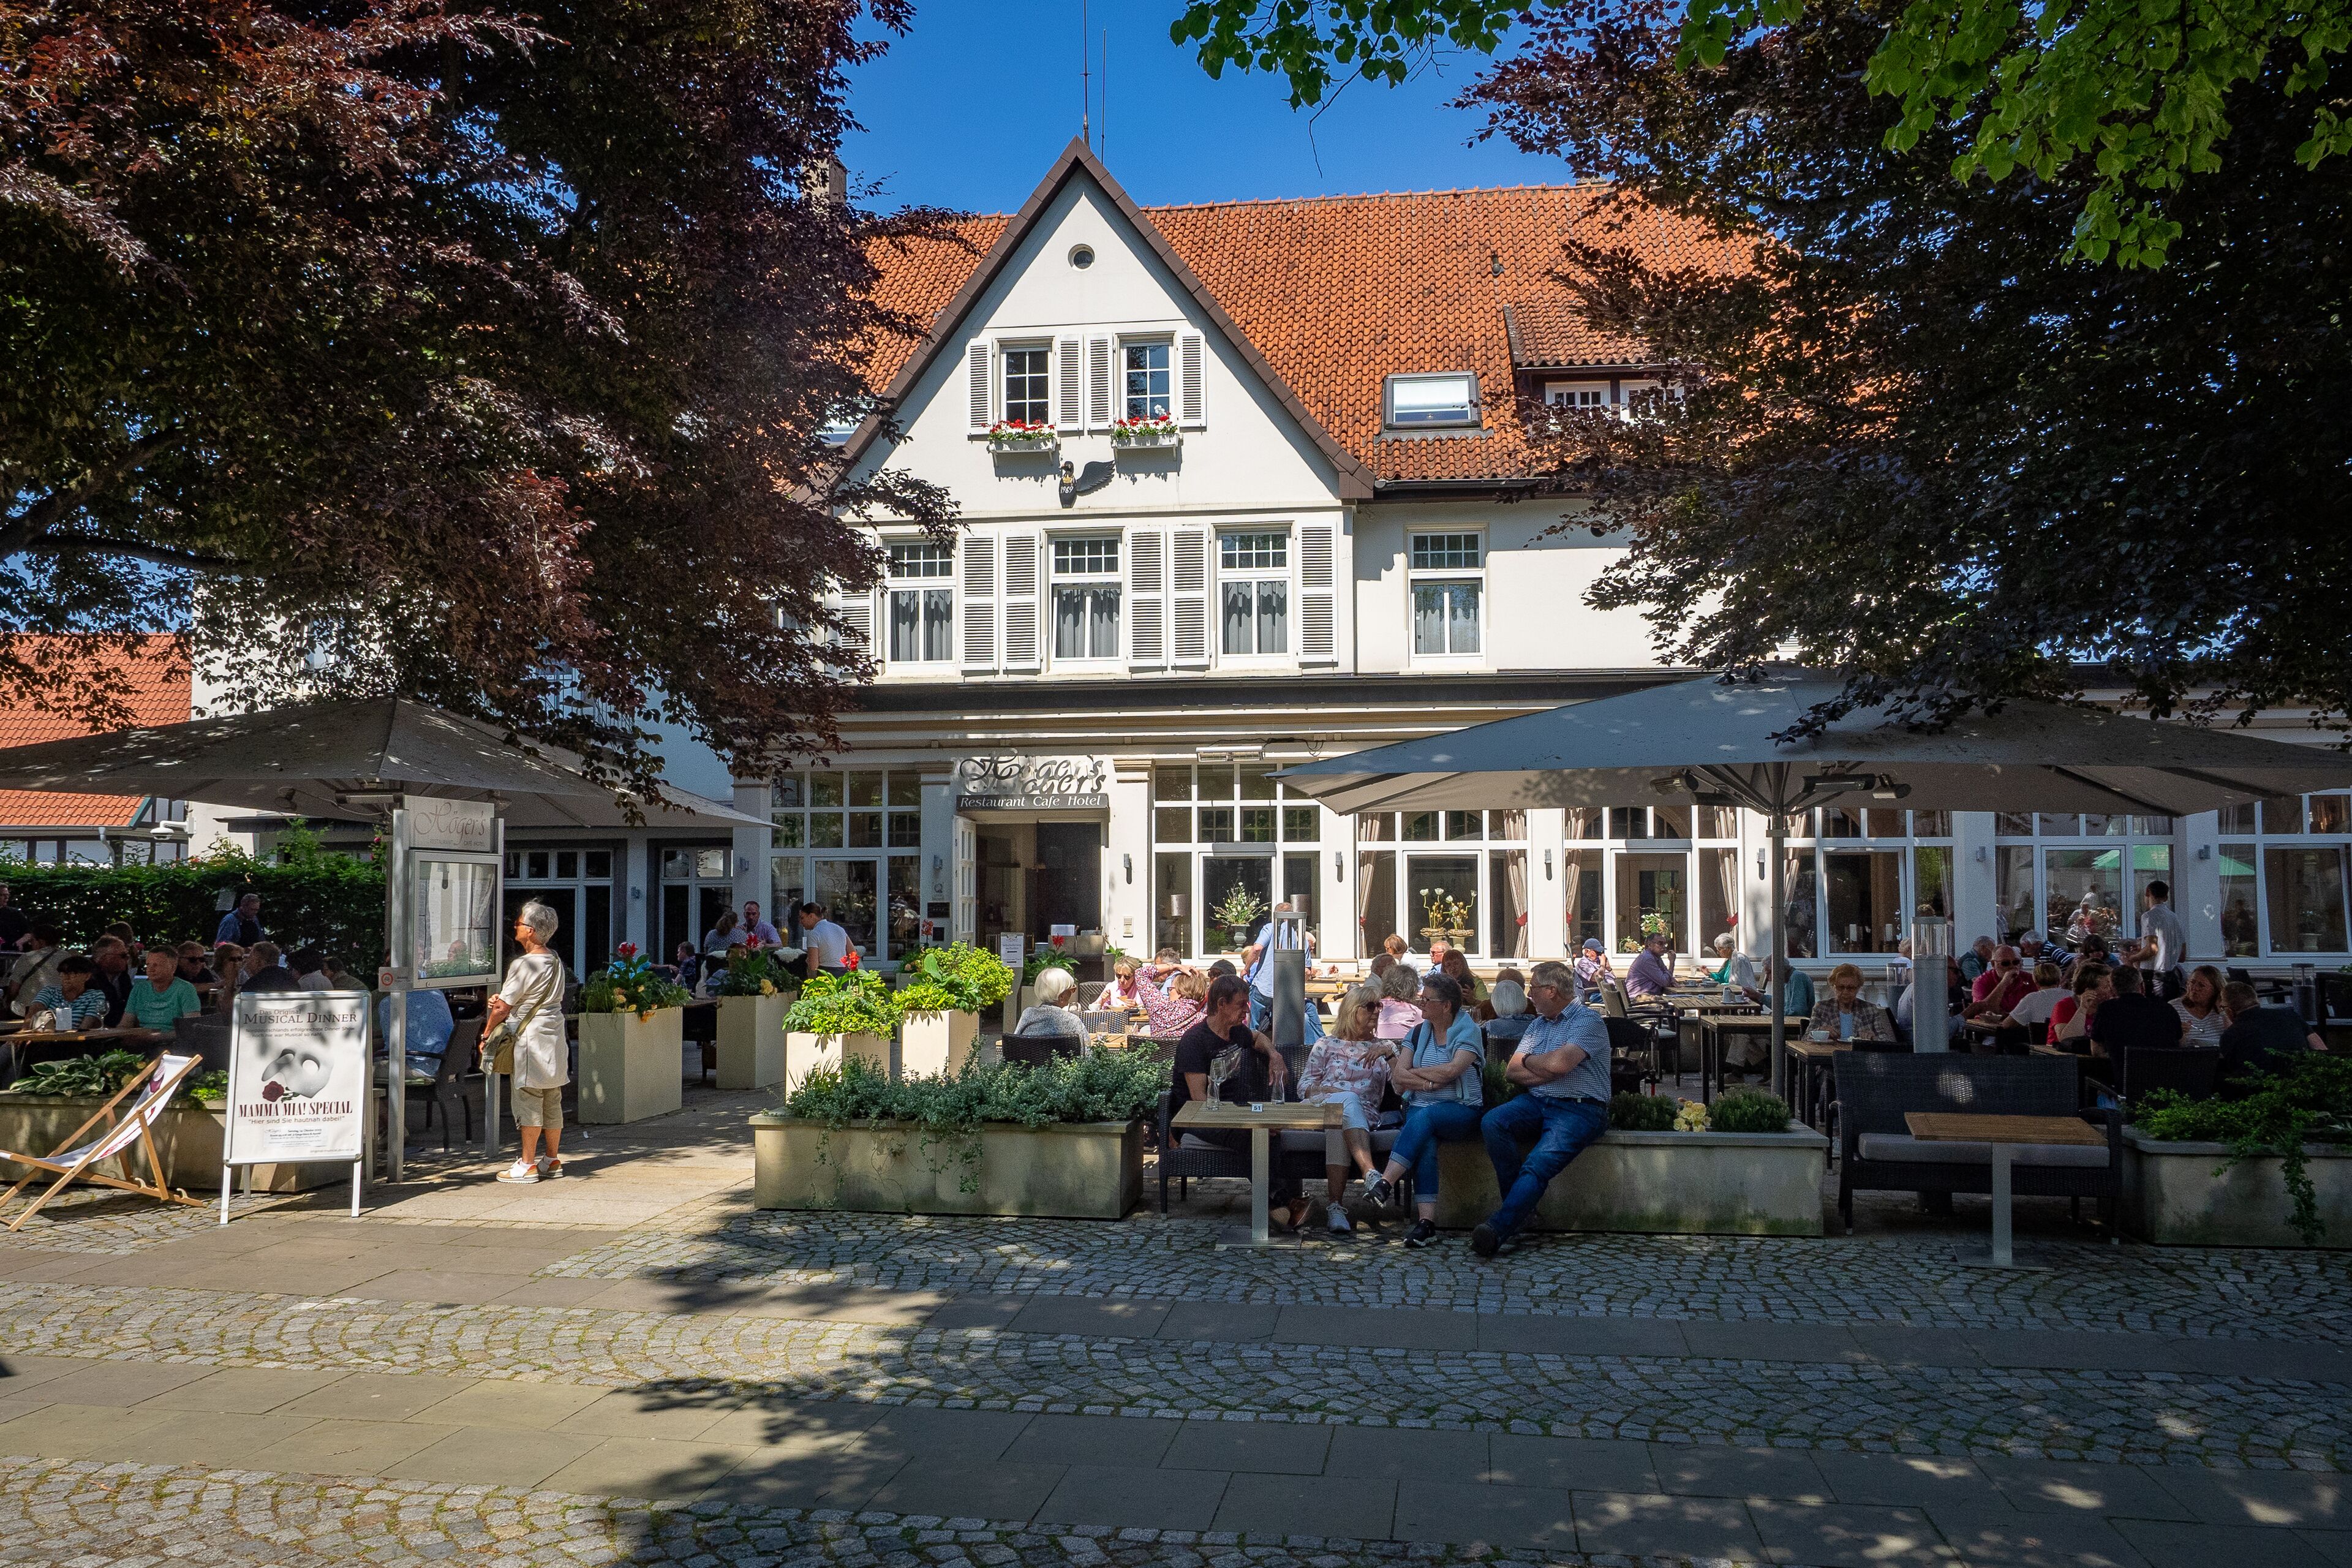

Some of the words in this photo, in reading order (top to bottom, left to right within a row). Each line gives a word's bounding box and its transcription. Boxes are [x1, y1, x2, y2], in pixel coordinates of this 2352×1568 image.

[960, 796, 1026, 807] Restaurant
[1033, 796, 1060, 809] Cafe
[1067, 795, 1101, 806] Hotel
[414, 802, 486, 845] Häger's
[244, 1013, 303, 1024] MUSICAL
[307, 1012, 357, 1023] DINNER
[238, 1103, 279, 1118] MAMMA
[282, 1102, 306, 1116] MIA!
[309, 1101, 353, 1115] SPECIAL
